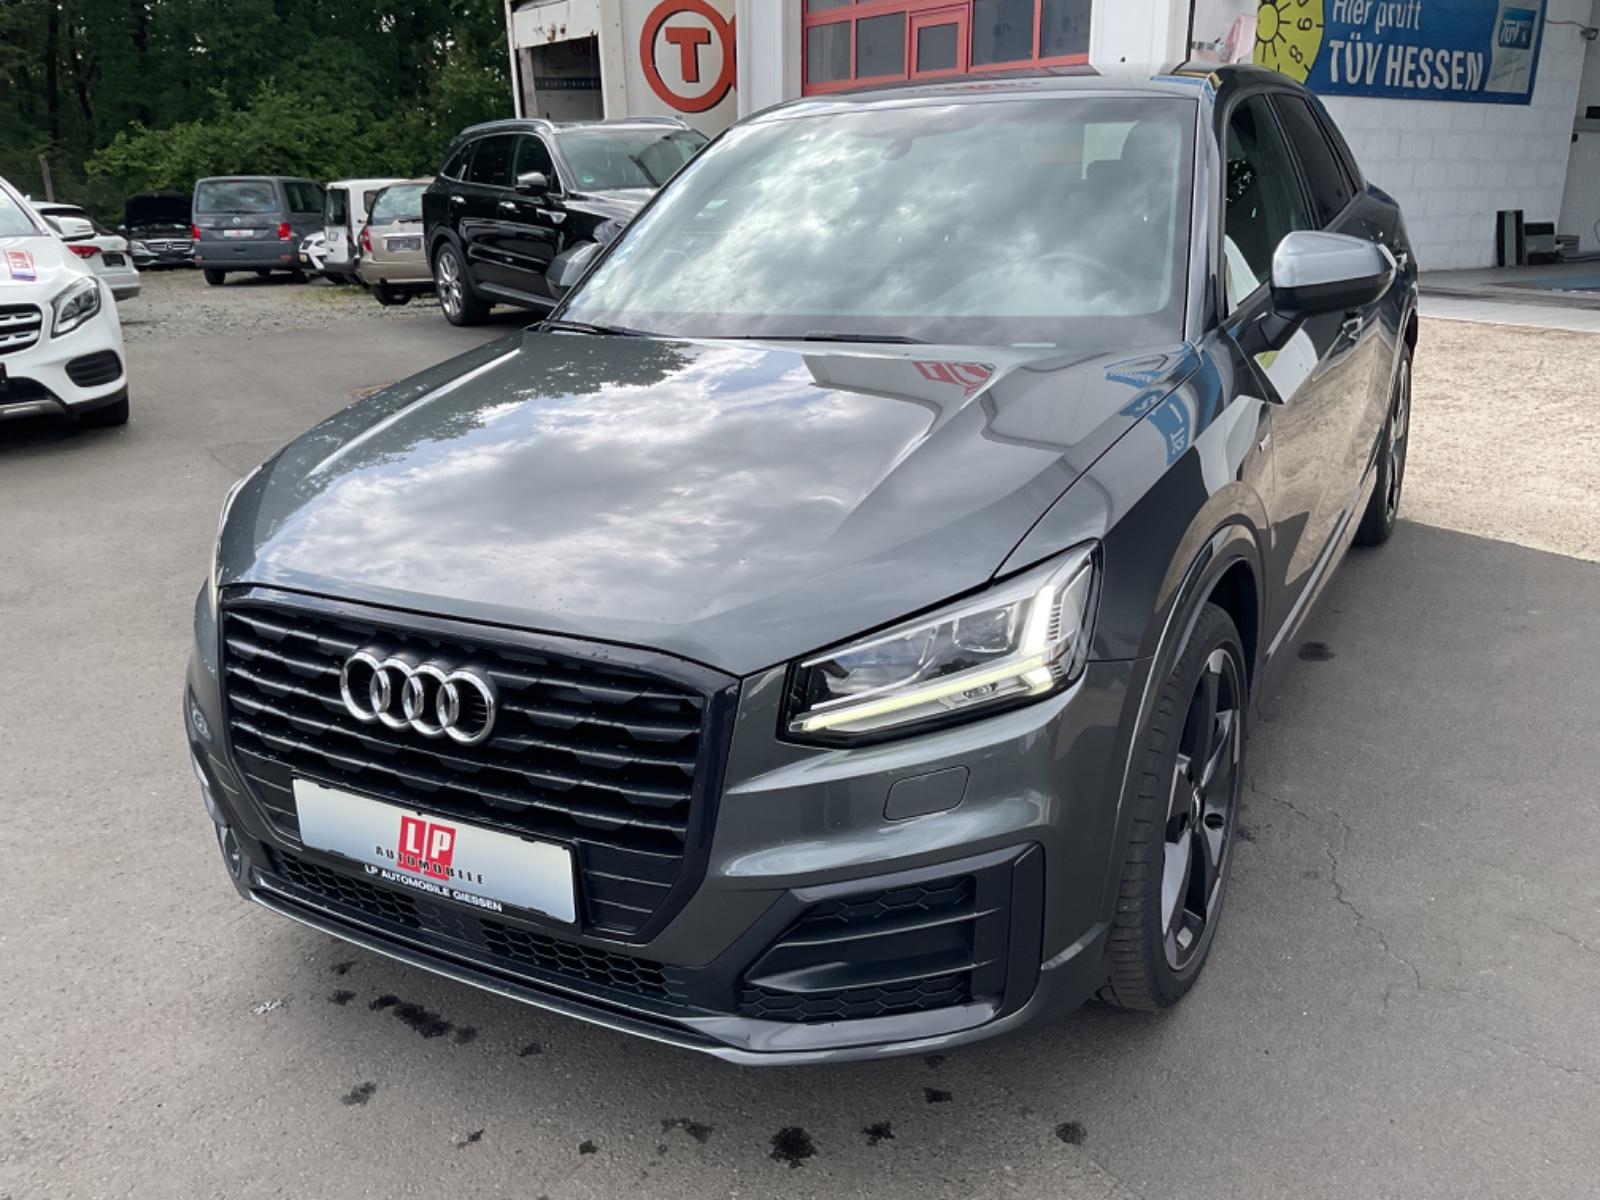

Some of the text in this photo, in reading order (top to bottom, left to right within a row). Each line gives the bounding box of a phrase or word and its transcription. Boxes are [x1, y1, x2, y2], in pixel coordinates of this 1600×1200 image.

[665, 27, 712, 83] T
[1329, 31, 1483, 91] TÜV HESSEN
[375, 845, 485, 885] AUTOMOBILE
[405, 822, 452, 860] LP
[364, 863, 503, 912] LP AUTOMOBILE GIESSEN
